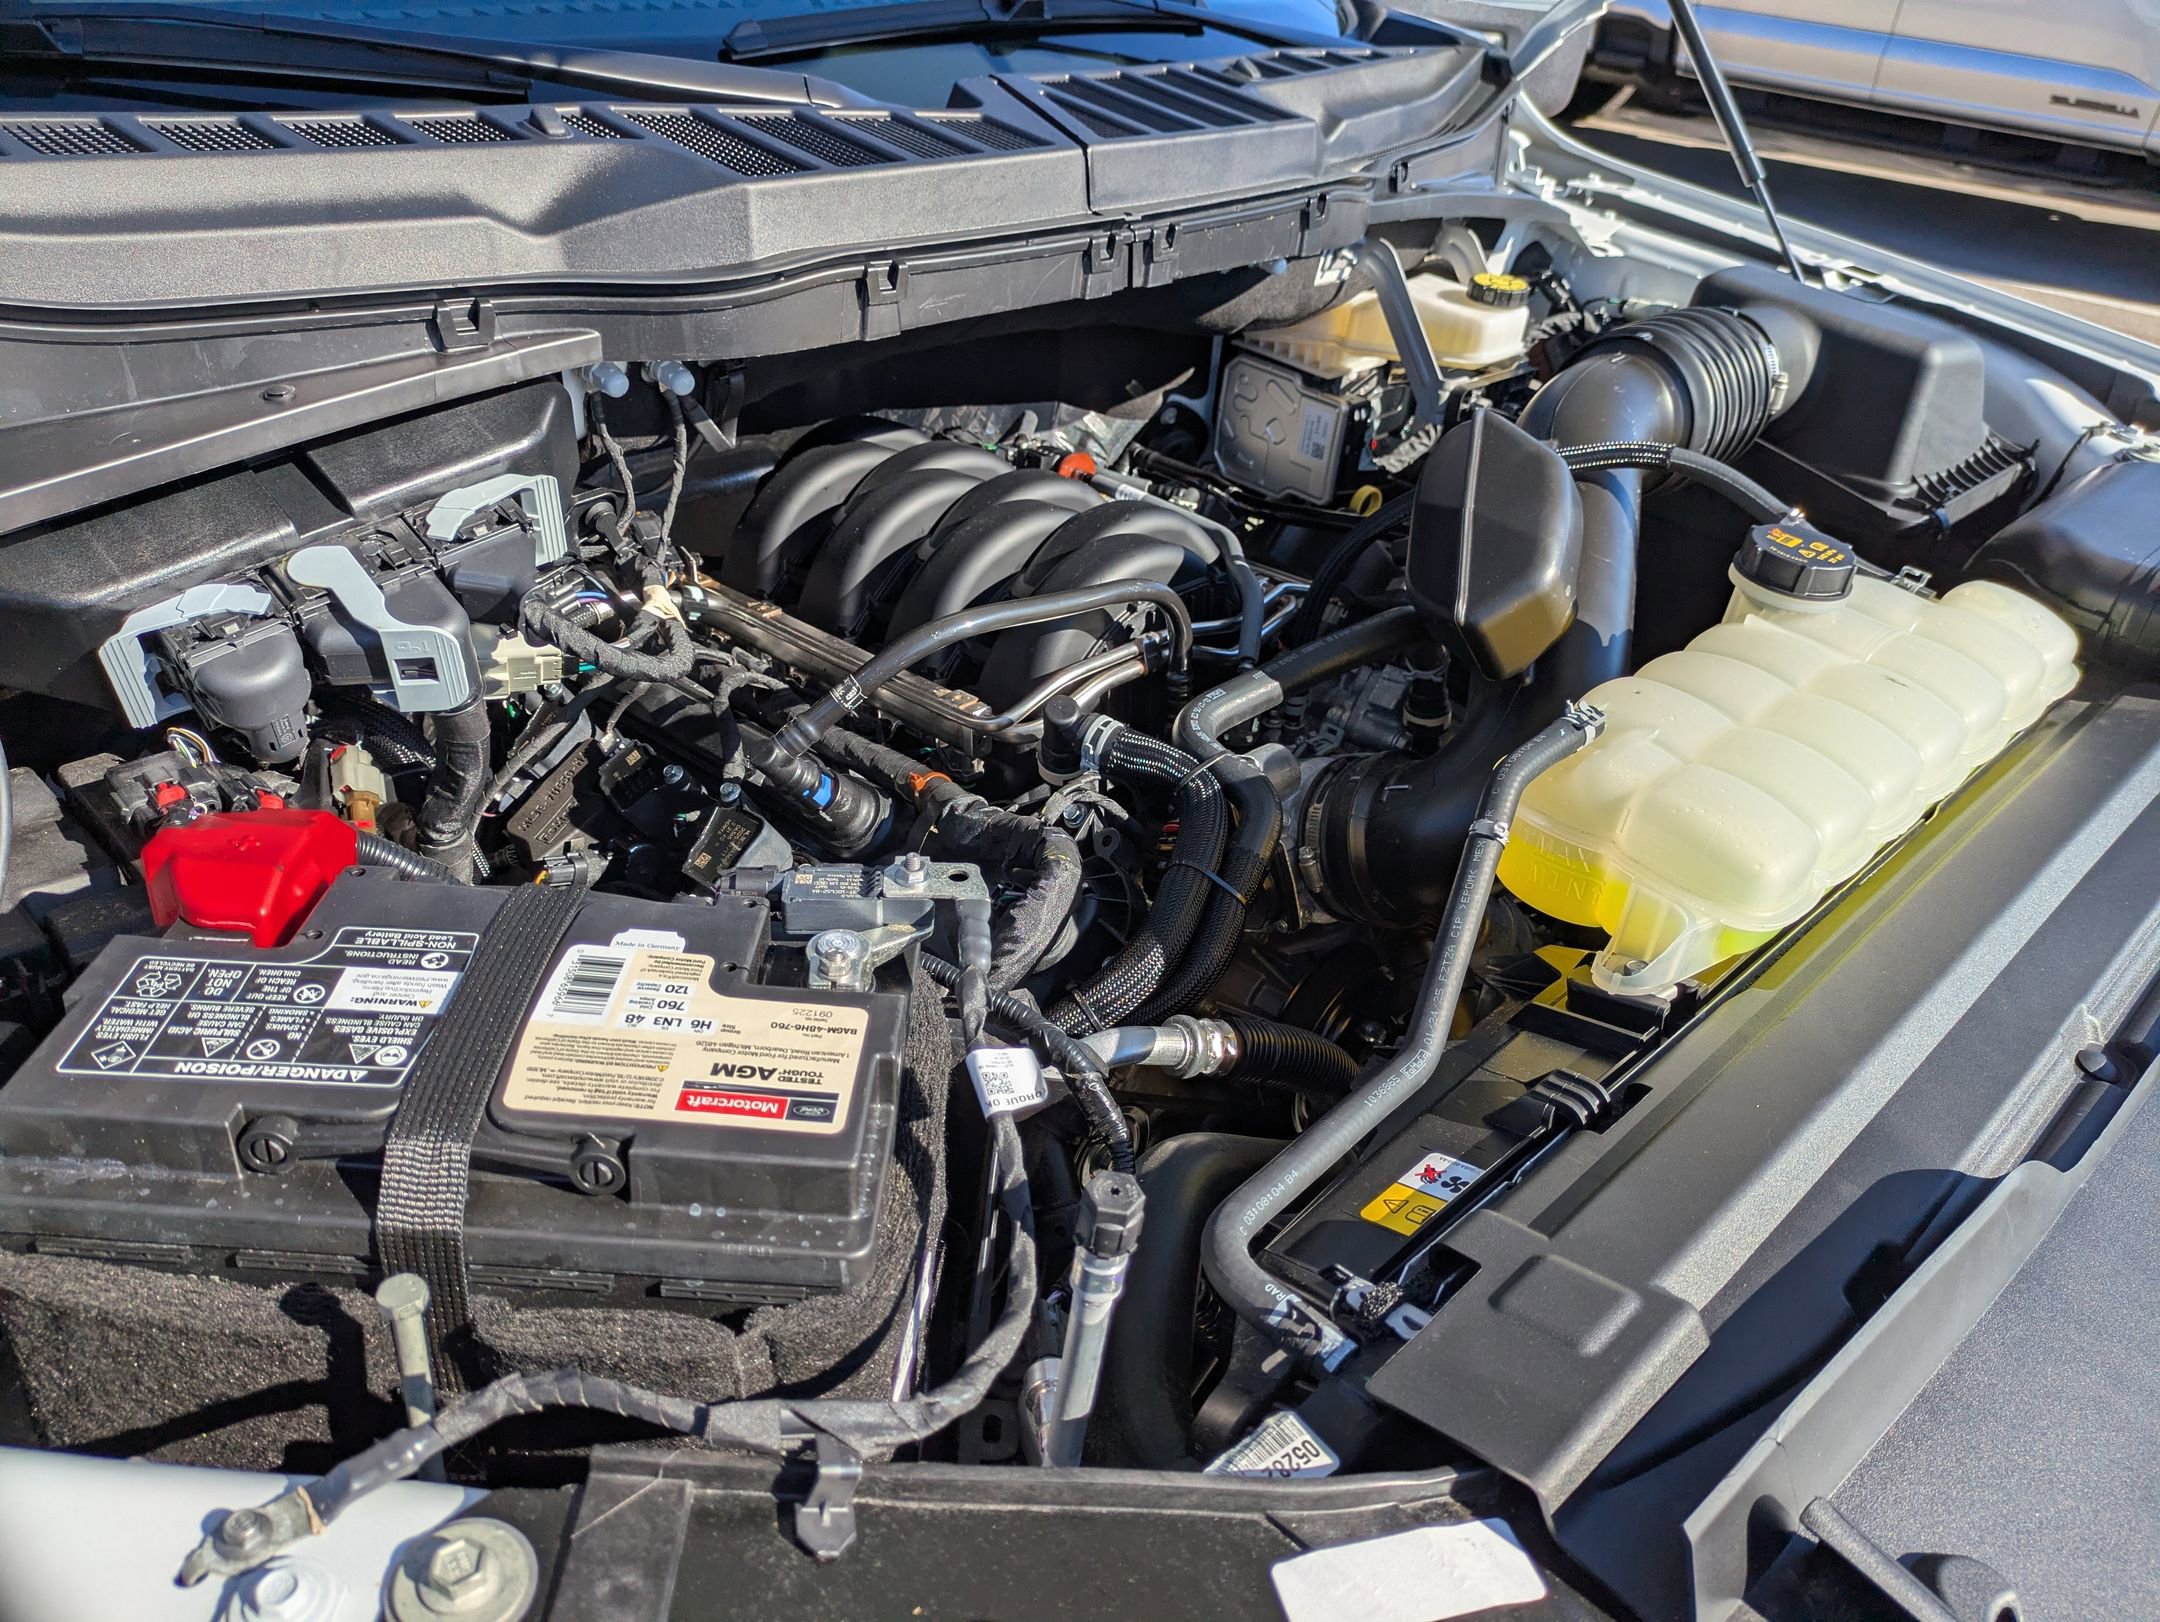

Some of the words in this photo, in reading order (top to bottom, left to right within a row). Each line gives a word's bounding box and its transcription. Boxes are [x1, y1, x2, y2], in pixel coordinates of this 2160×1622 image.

[1537, 833, 1594, 872] MAX
[365, 931, 401, 940] Battery
[355, 937, 456, 949] NON-SPILLABLE
[646, 943, 681, 951] Germany
[344, 951, 419, 959] INSTRUCTIONS.
[207, 969, 242, 979] OPEN.
[258, 969, 302, 977] CHILDREN.
[1363, 1074, 1400, 1109] 1036865
[1402, 1051, 1429, 1076] FoMoCo
[1423, 988, 1443, 1045] 01/24/25
[1450, 916, 1463, 938] CIP
[1473, 840, 1486, 862] MEX
[206, 978, 233, 987] NOT
[268, 977, 296, 985] REACH
[353, 973, 449, 983] www.P65Warnings.ca.gov
[204, 987, 223, 996] DO
[384, 986, 432, 994] Reproductive
[665, 984, 689, 994] 120
[350, 997, 418, 1007] WARNING:
[657, 1000, 685, 1011] 760
[110, 1006, 148, 1015] MEDICAL
[190, 1004, 222, 1012] BURNS.
[222, 1005, 255, 1013] SEVERE
[268, 1008, 308, 1016] SMOKING
[202, 1012, 250, 1020] BLINDNESS
[792, 1008, 833, 1019] 091225
[102, 1018, 133, 1027] WATER.
[325, 1018, 373, 1026] BLINDNESS
[625, 1014, 646, 1024] 48
[653, 1017, 683, 1028] LN3
[94, 1024, 154, 1034] IMMEDIATELY
[265, 1023, 300, 1031] SPARKS
[333, 1025, 365, 1033] GASES
[691, 1019, 712, 1030] H6
[771, 1022, 858, 1036] BAGM-48H6-760
[167, 1026, 192, 1034] ACID
[192, 1027, 241, 1037] SULFURIC
[366, 1026, 417, 1036] EXPLOSIVE
[96, 1031, 119, 1039] EYES
[120, 1031, 149, 1041] FLUSH
[287, 1032, 302, 1040] NO
[352, 1035, 378, 1043] EYES.
[380, 1036, 413, 1045] SHIELD
[701, 1047, 737, 1055] Company
[719, 1042, 752, 1051] Michigan
[752, 1045, 789, 1053] Dearborn,
[811, 1050, 847, 1058] American
[789, 1054, 840, 1064] Manufactured
[174, 1062, 349, 1080] DANGER/POISON
[710, 1063, 778, 1081] AGM
[778, 1076, 822, 1085] TESTED
[687, 1096, 778, 1113] Motorcraft
[1244, 1182, 1286, 1225] 03:08:04
[1284, 1169, 1298, 1184] B4
[1264, 1283, 1286, 1301] RAD
